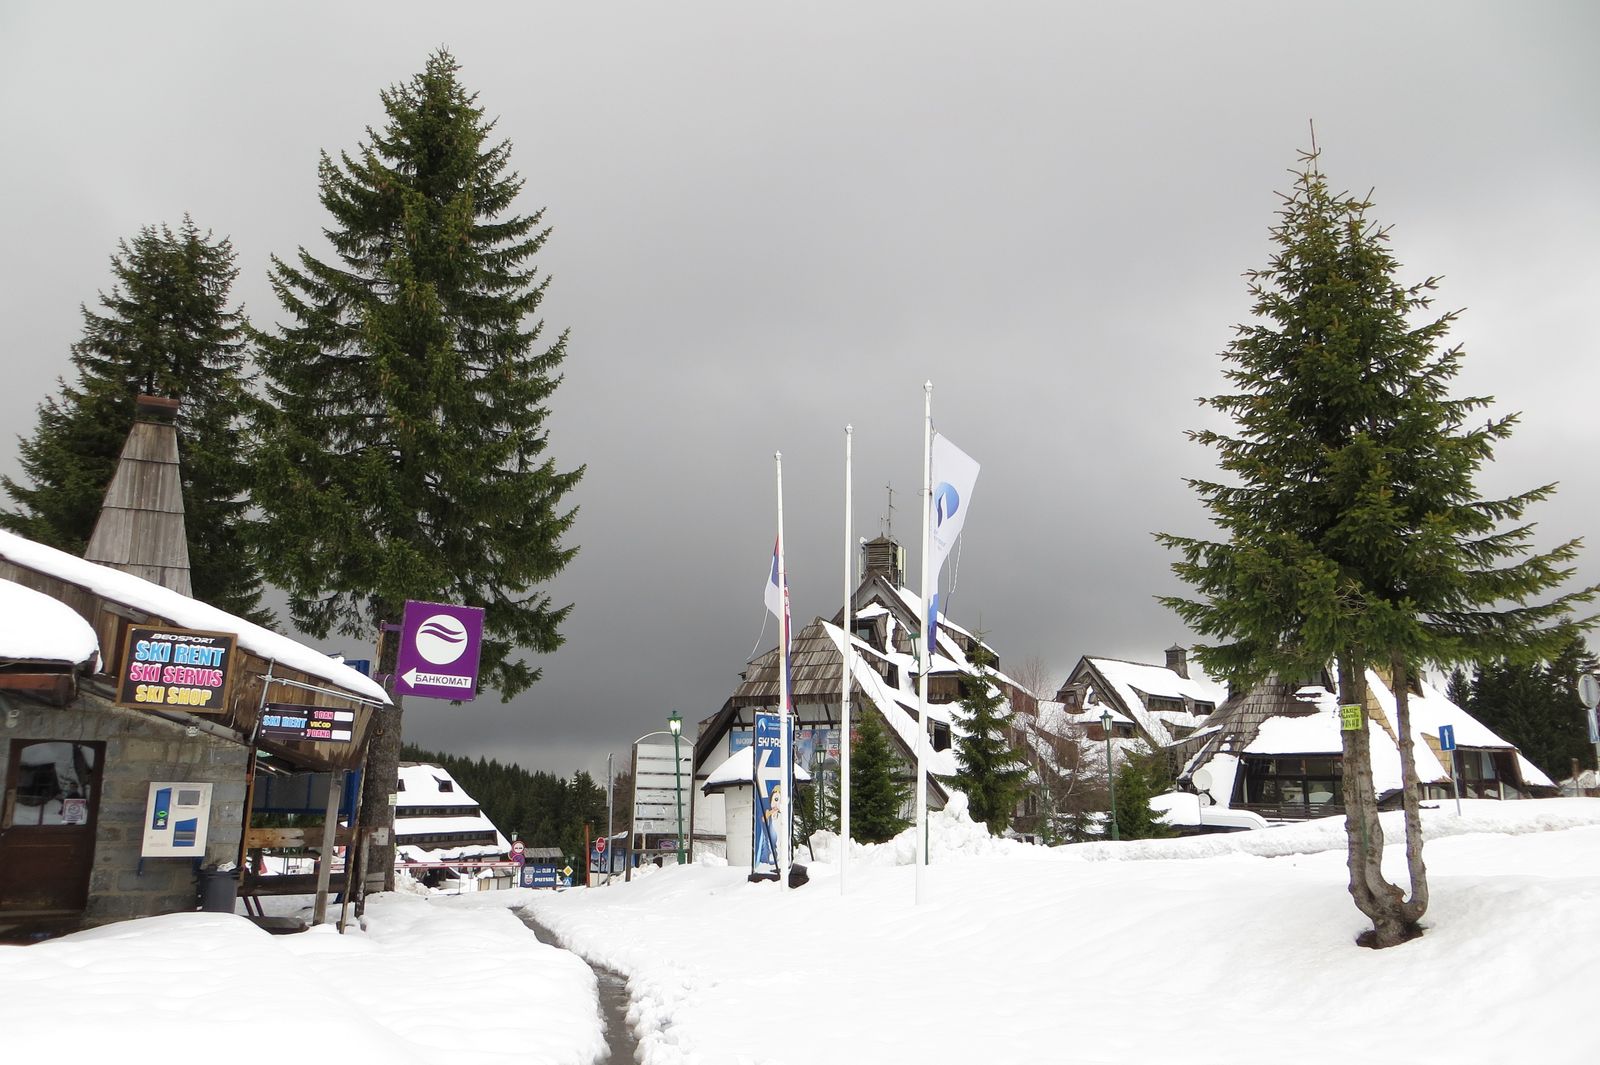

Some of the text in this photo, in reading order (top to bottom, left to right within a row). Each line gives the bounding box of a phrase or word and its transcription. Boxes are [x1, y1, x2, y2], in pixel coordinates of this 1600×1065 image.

[150, 633, 215, 644] BEOSPORT
[135, 640, 226, 667] SKI RENT
[130, 662, 223, 688] SKI SERVIS
[415, 674, 469, 686] БАНКОМАТ
[135, 684, 212, 706] SKI SHOP
[263, 715, 308, 729] SKI RENT
[758, 737, 770, 747] SKI
